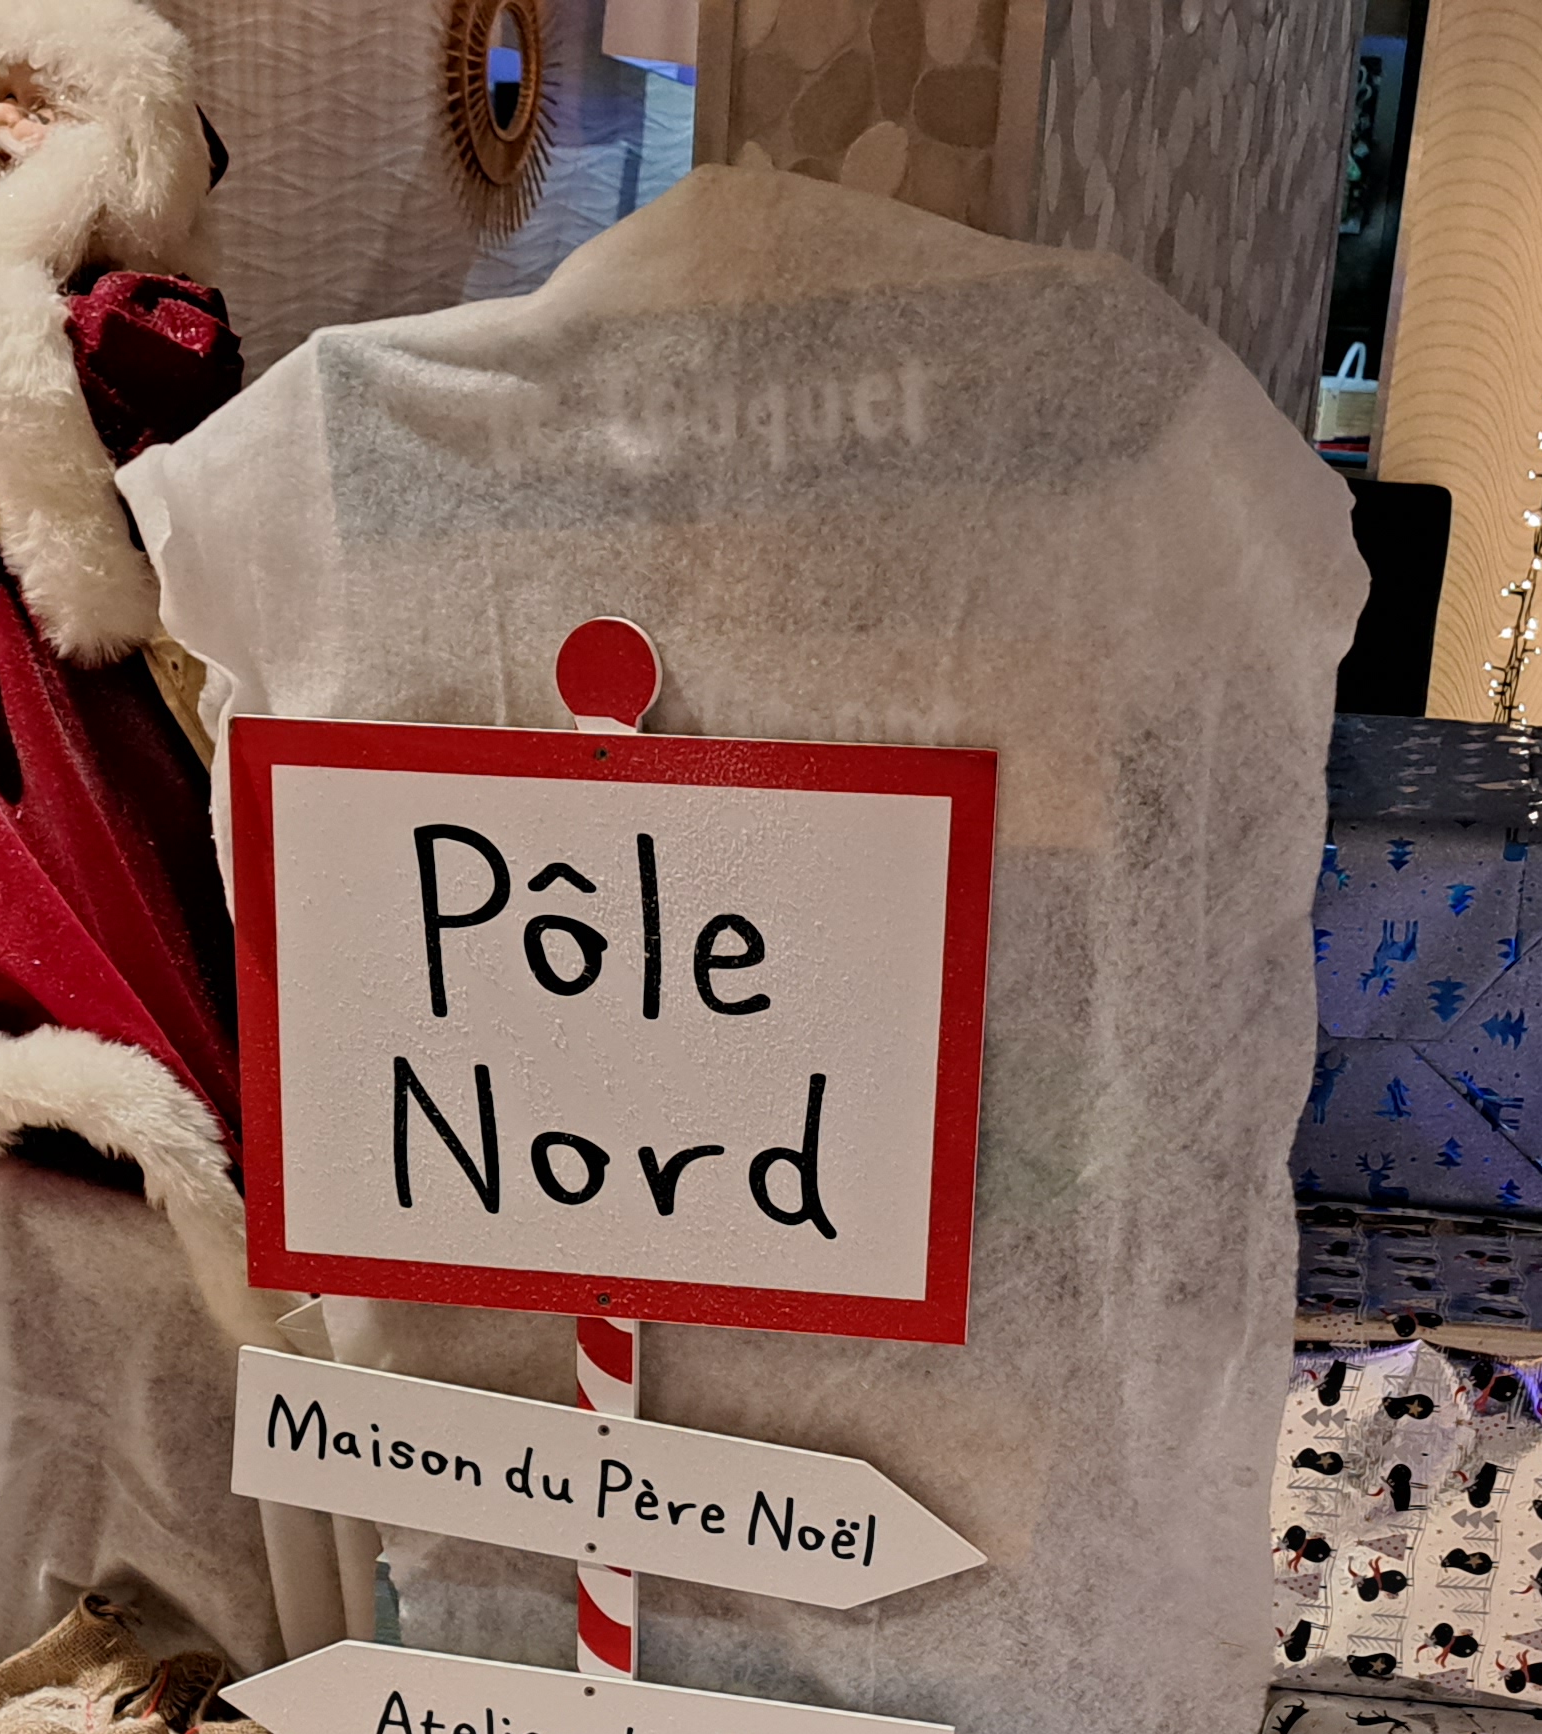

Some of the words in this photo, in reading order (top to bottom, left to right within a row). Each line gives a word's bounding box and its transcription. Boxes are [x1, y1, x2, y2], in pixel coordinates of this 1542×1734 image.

[412, 823, 772, 1019] Pôle
[393, 1055, 838, 1240] Nord
[266, 1394, 483, 1488] Maison
[505, 1447, 575, 1505] du
[596, 1459, 727, 1534] Père
[747, 1490, 877, 1568] Noël
